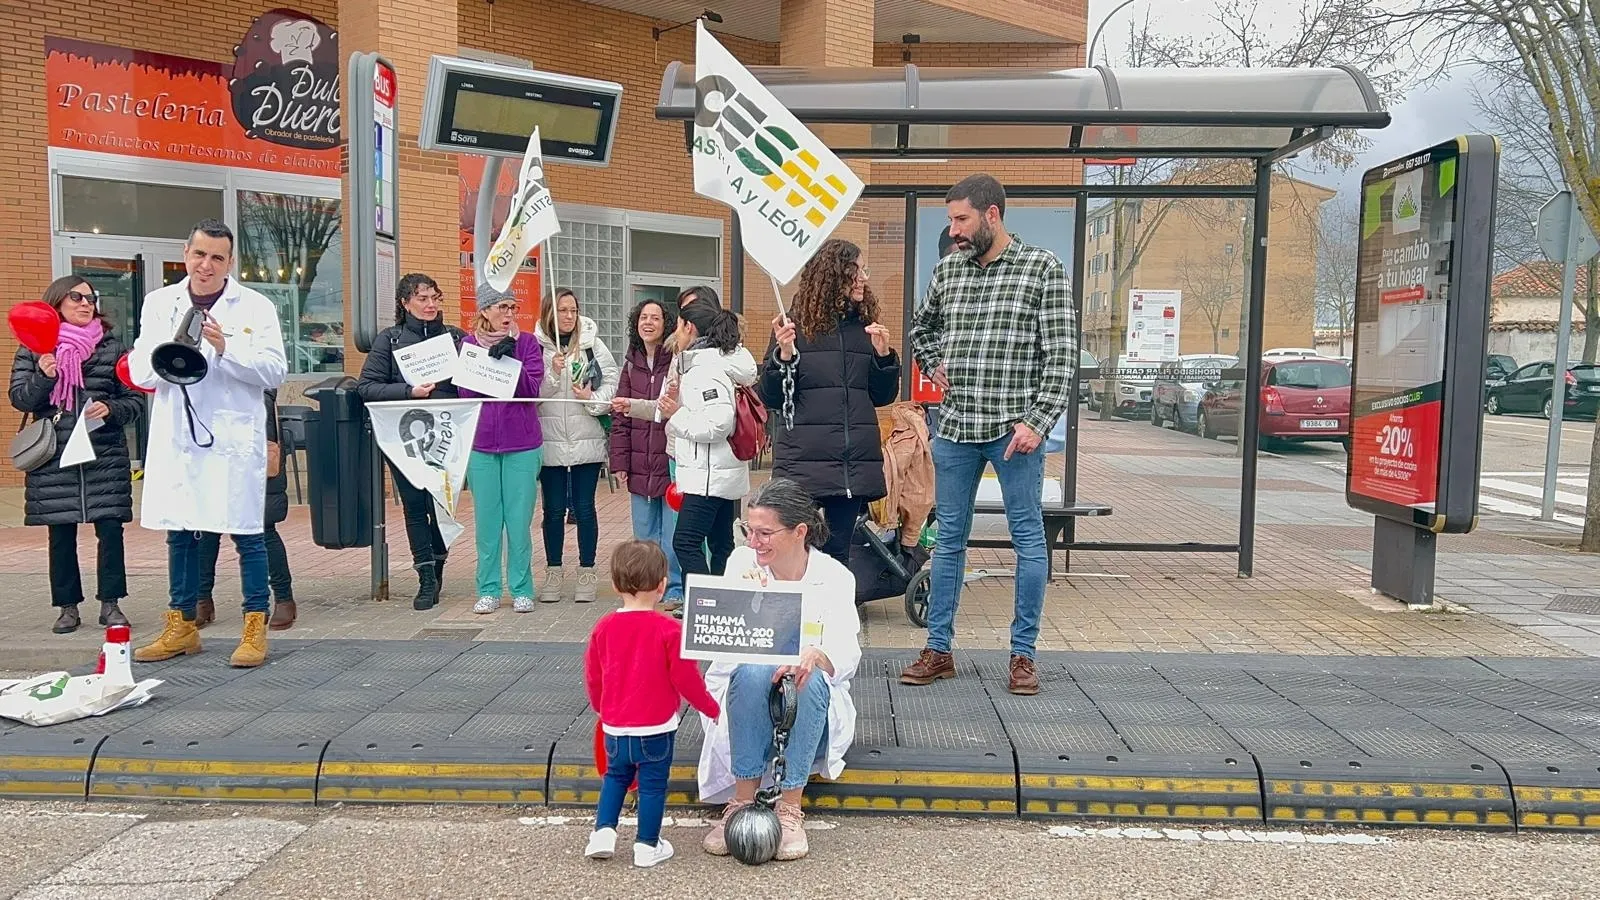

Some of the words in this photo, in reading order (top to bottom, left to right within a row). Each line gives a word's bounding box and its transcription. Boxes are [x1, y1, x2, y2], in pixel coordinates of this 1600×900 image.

[374, 75, 390, 97] BUS
[56, 83, 228, 127] Pastelería
[264, 128, 292, 139] Obrador
[293, 131, 303, 139] de
[374, 125, 380, 148] 1
[457, 133, 477, 144] Soria
[61, 128, 160, 151] Productos
[166, 142, 252, 161] artesanos
[257, 149, 277, 163] de
[568, 147, 589, 156] avanza
[374, 154, 380, 175] 3
[374, 181, 380, 203] 4
[375, 210, 382, 230] C
[758, 200, 811, 248] LEÓN
[1393, 237, 1430, 265] cambio
[1377, 272, 1384, 288] a
[1386, 268, 1398, 288] tu
[1399, 265, 1429, 290] hogar
[1371, 398, 1393, 411] EXCLUSIVO
[1393, 395, 1409, 406] SOCIOS
[1389, 414, 1403, 423] Ahorra
[1375, 425, 1413, 458] -20%
[1380, 457, 1398, 469] proyecto
[1404, 462, 1417, 471] cocina
[694, 614, 709, 623] MI
[710, 613, 746, 627] MAMÁ
[693, 634, 734, 646] HORAS
[734, 636, 749, 647] AL
[749, 638, 774, 648] MES
[694, 624, 744, 636] TRABAJA
[752, 628, 775, 638] 200
